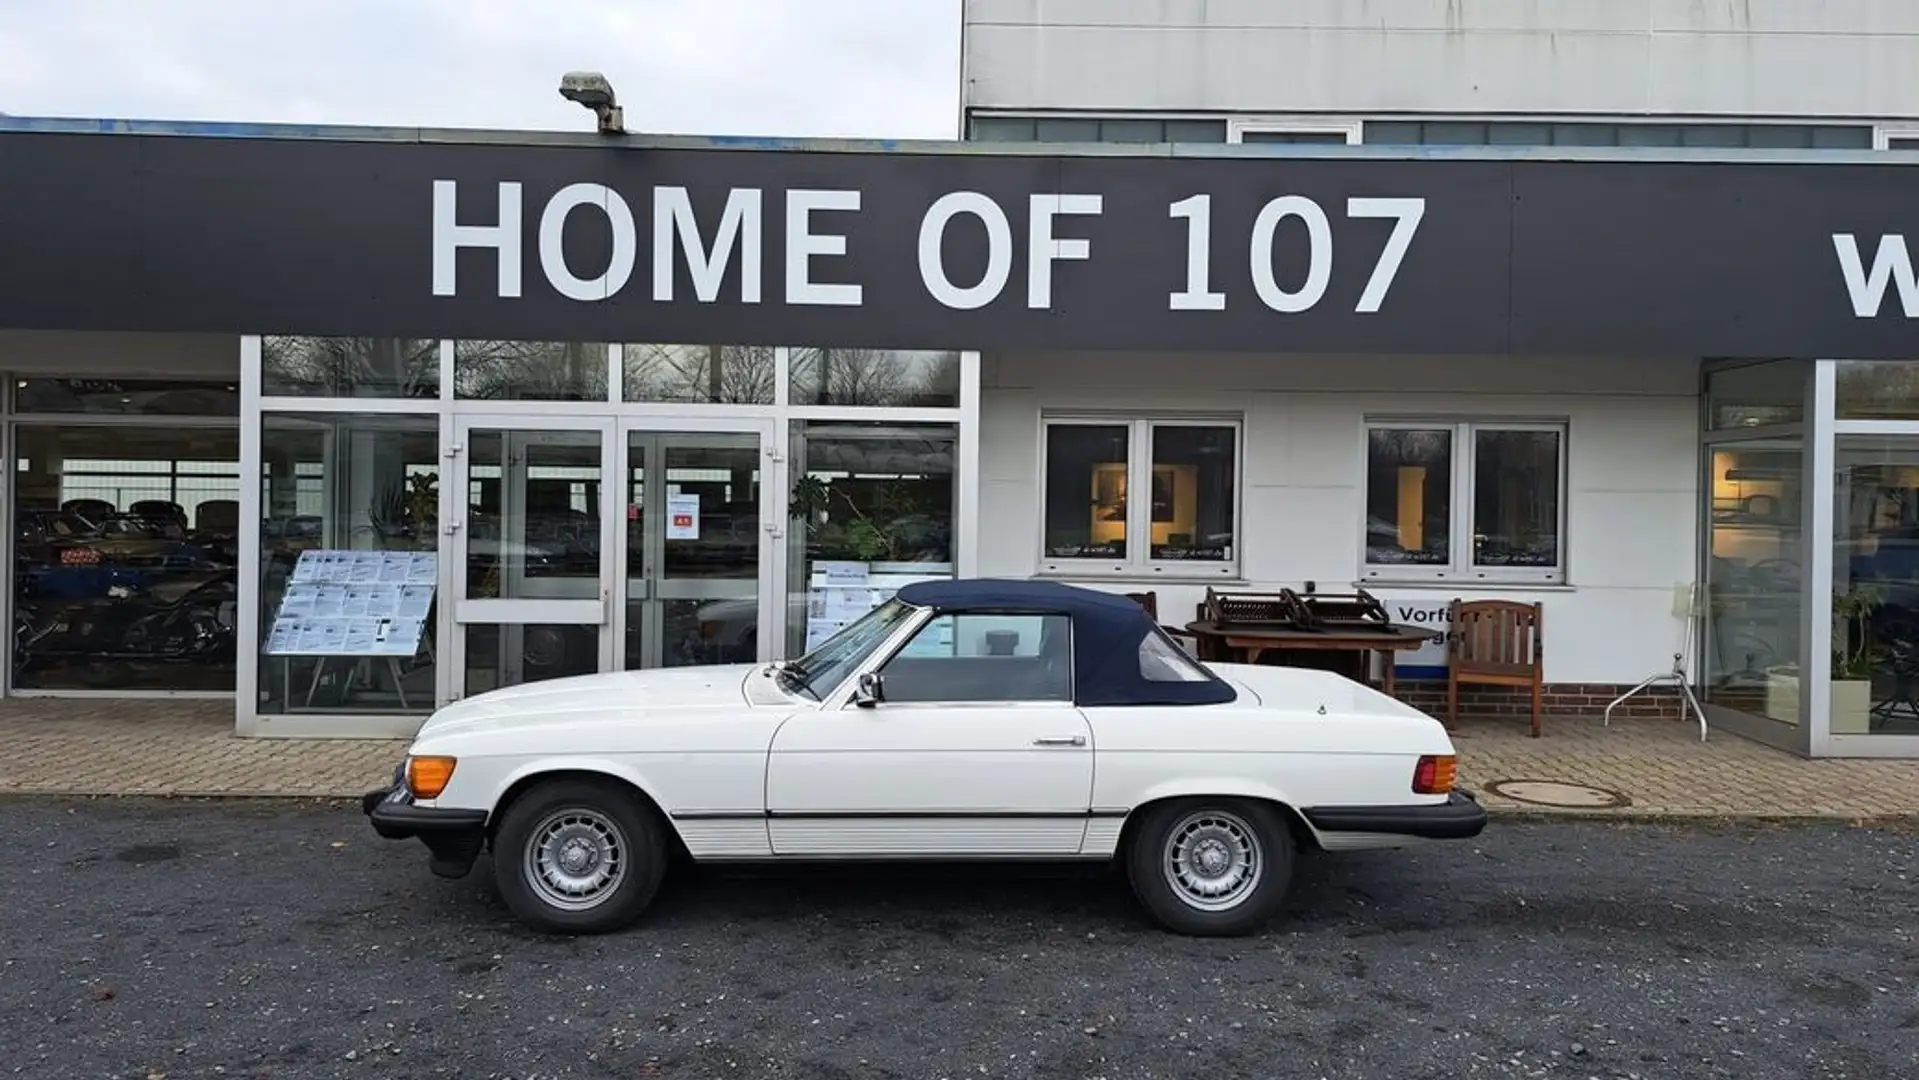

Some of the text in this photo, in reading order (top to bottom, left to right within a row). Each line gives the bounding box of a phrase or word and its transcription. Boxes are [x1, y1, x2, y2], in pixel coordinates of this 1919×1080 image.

[432, 179, 1426, 314] HOME OF 107
